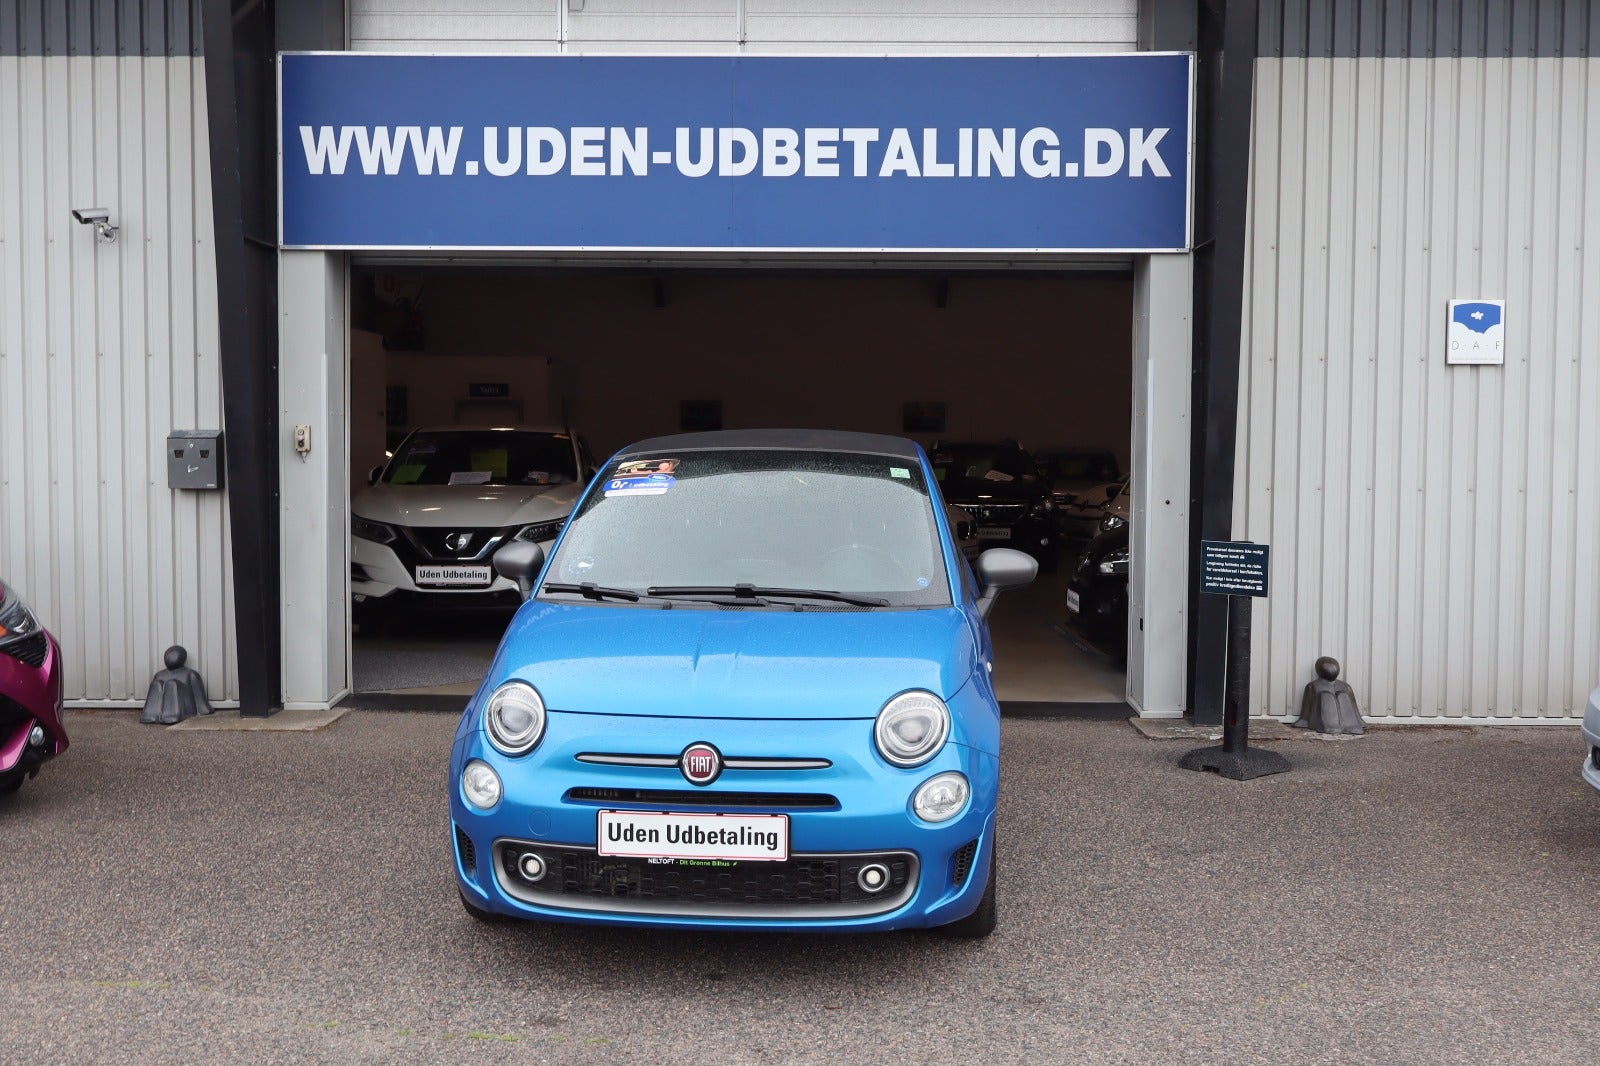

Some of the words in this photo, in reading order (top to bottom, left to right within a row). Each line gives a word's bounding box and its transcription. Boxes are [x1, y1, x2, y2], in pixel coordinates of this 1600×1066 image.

[299, 125, 1171, 179] WWW.UDEN-UDBETALING.DK
[419, 569, 441, 579] Uden
[442, 569, 488, 580] Udbetaling
[690, 756, 712, 773] FIAT
[607, 822, 660, 843] Uden
[666, 824, 778, 851] Udbetaling
[647, 857, 675, 865] NELTOFT
